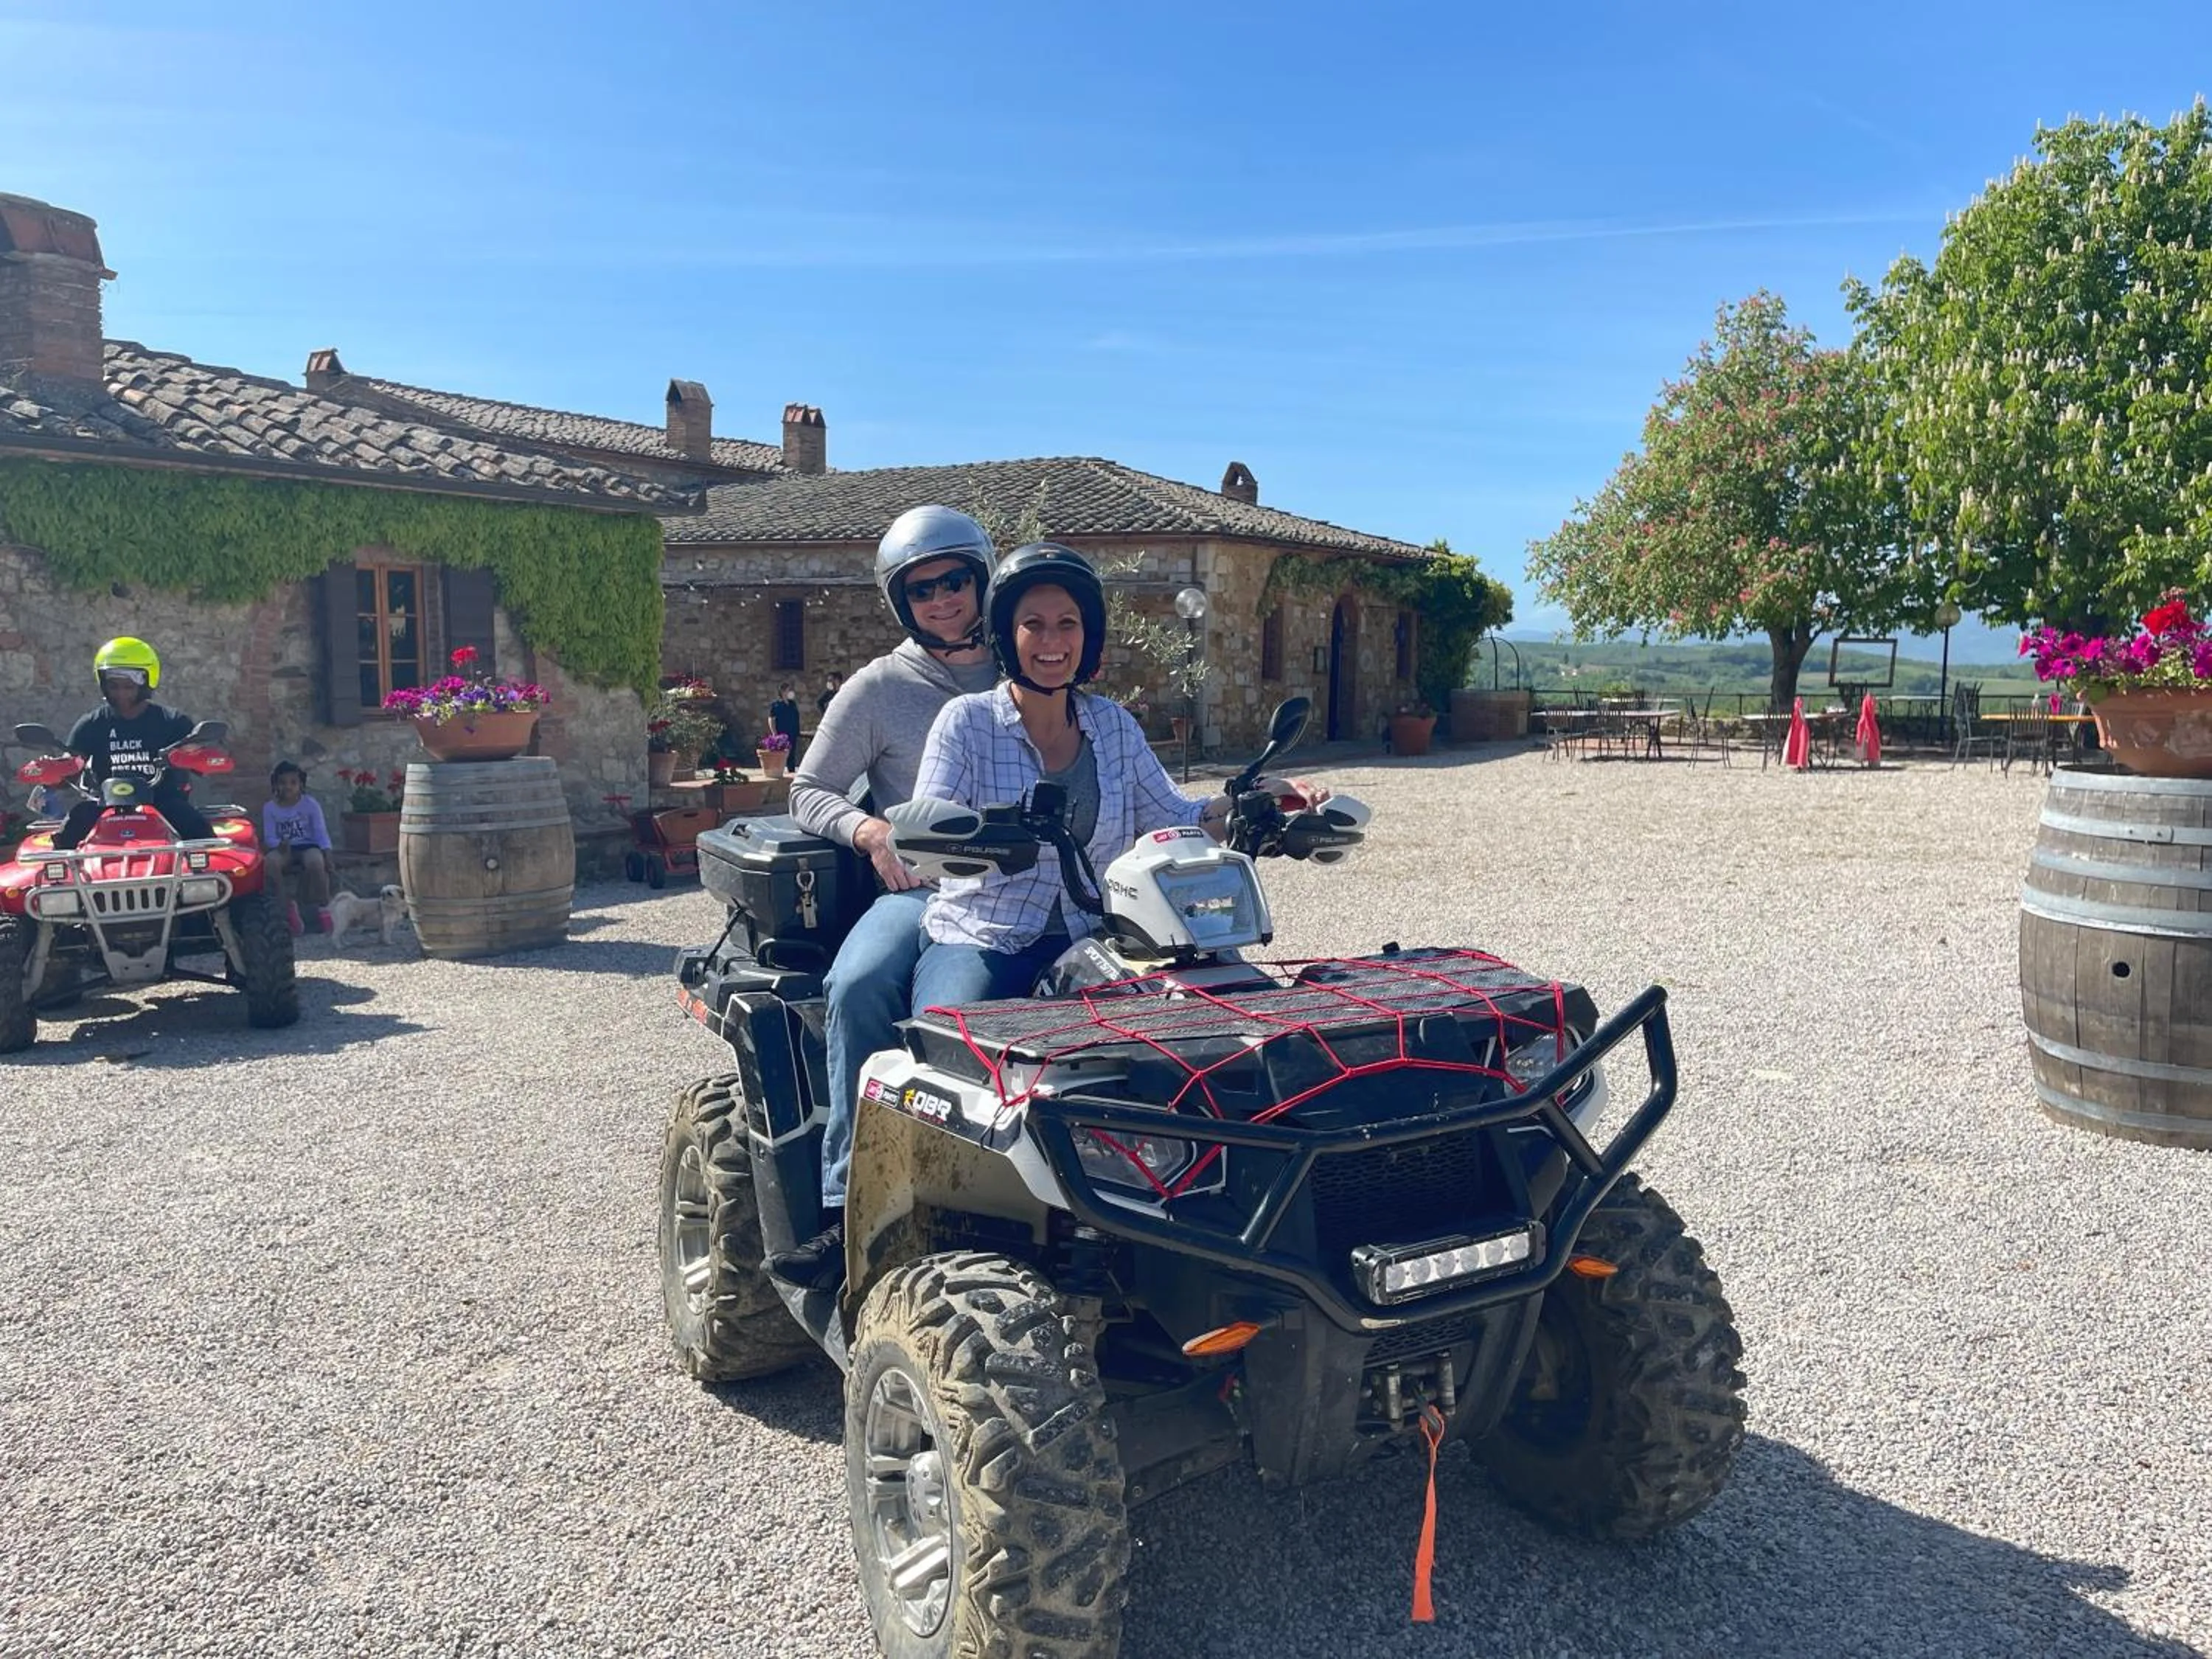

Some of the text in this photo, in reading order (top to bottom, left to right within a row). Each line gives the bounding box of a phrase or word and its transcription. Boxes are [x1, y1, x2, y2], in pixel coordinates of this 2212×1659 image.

[110, 728, 116, 737] A
[110, 740, 142, 751] BLACK
[110, 751, 150, 764] WOMAN
